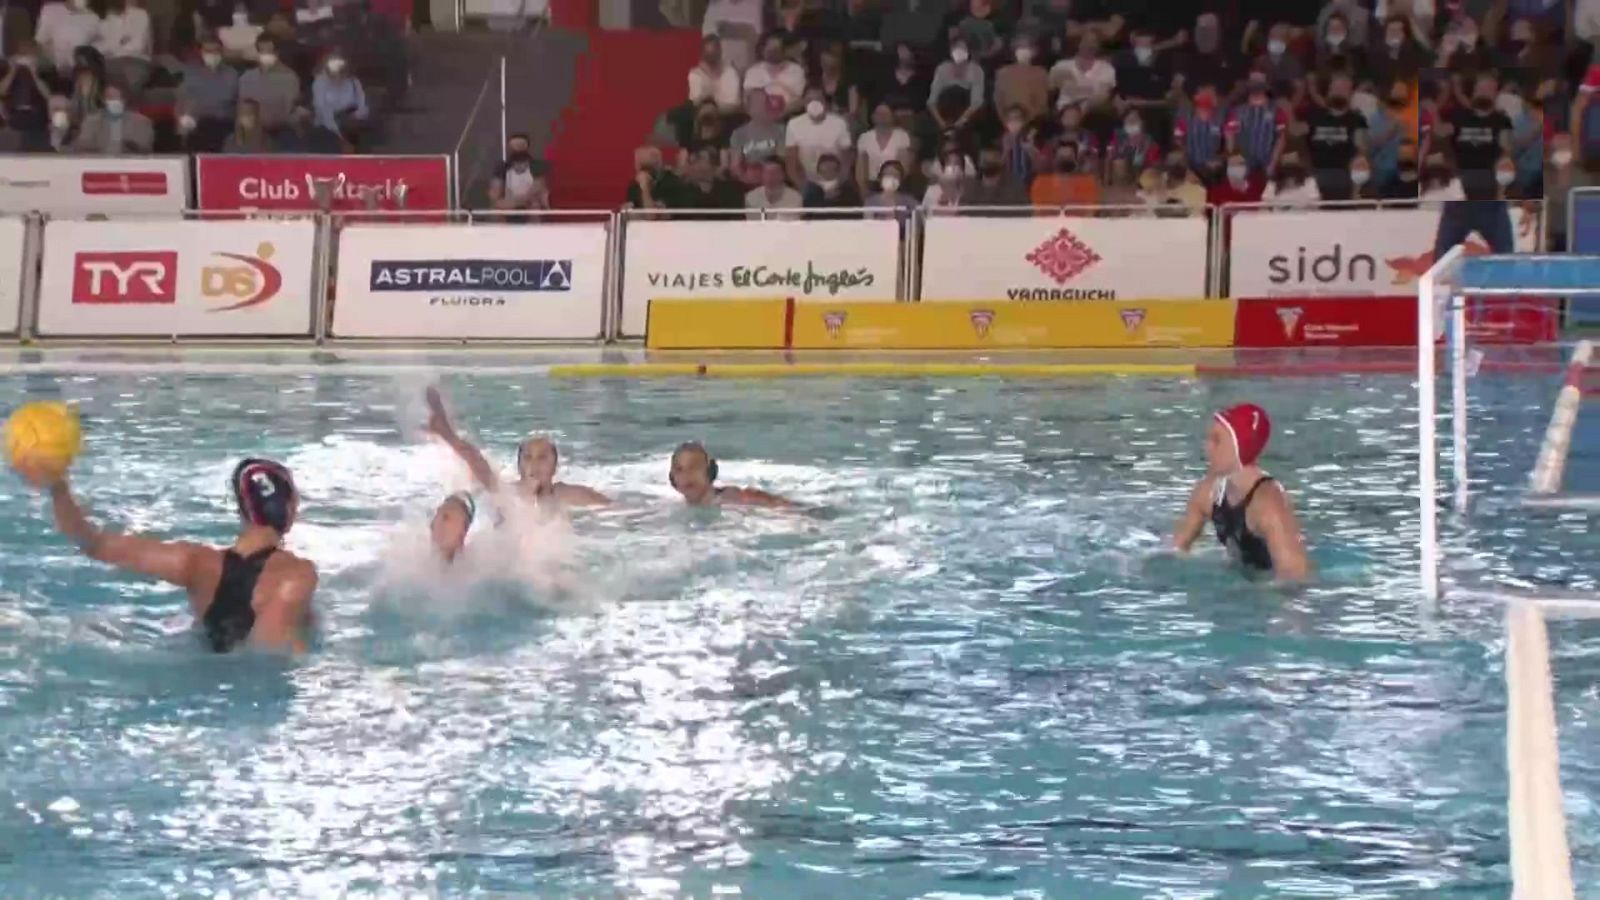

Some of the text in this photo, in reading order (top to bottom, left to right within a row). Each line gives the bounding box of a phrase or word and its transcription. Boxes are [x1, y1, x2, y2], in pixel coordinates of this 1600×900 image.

[239, 177, 299, 200] Club
[1268, 244, 1376, 283] sidn
[82, 261, 166, 295] TYR
[375, 267, 535, 285] ASTRALPOOL
[647, 273, 724, 291] VIAJES
[1007, 287, 1116, 301] YAMAGUCHI
[251, 472, 276, 497] 3
